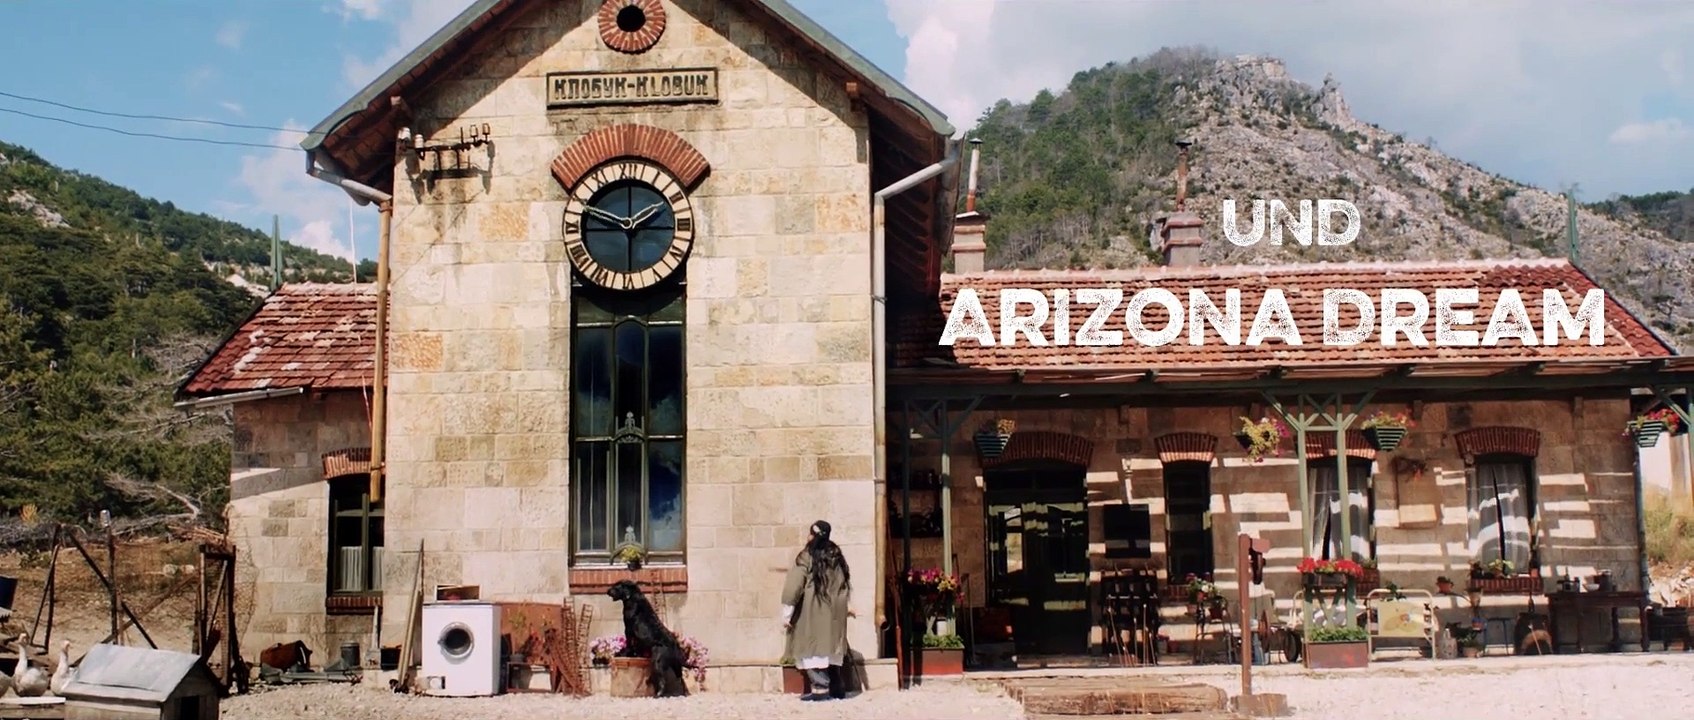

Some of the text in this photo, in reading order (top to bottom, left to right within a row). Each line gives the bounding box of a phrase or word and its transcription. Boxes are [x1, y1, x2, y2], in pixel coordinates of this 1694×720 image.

[619, 164, 638, 179] XII
[669, 191, 684, 205] II
[677, 217, 691, 232] III
